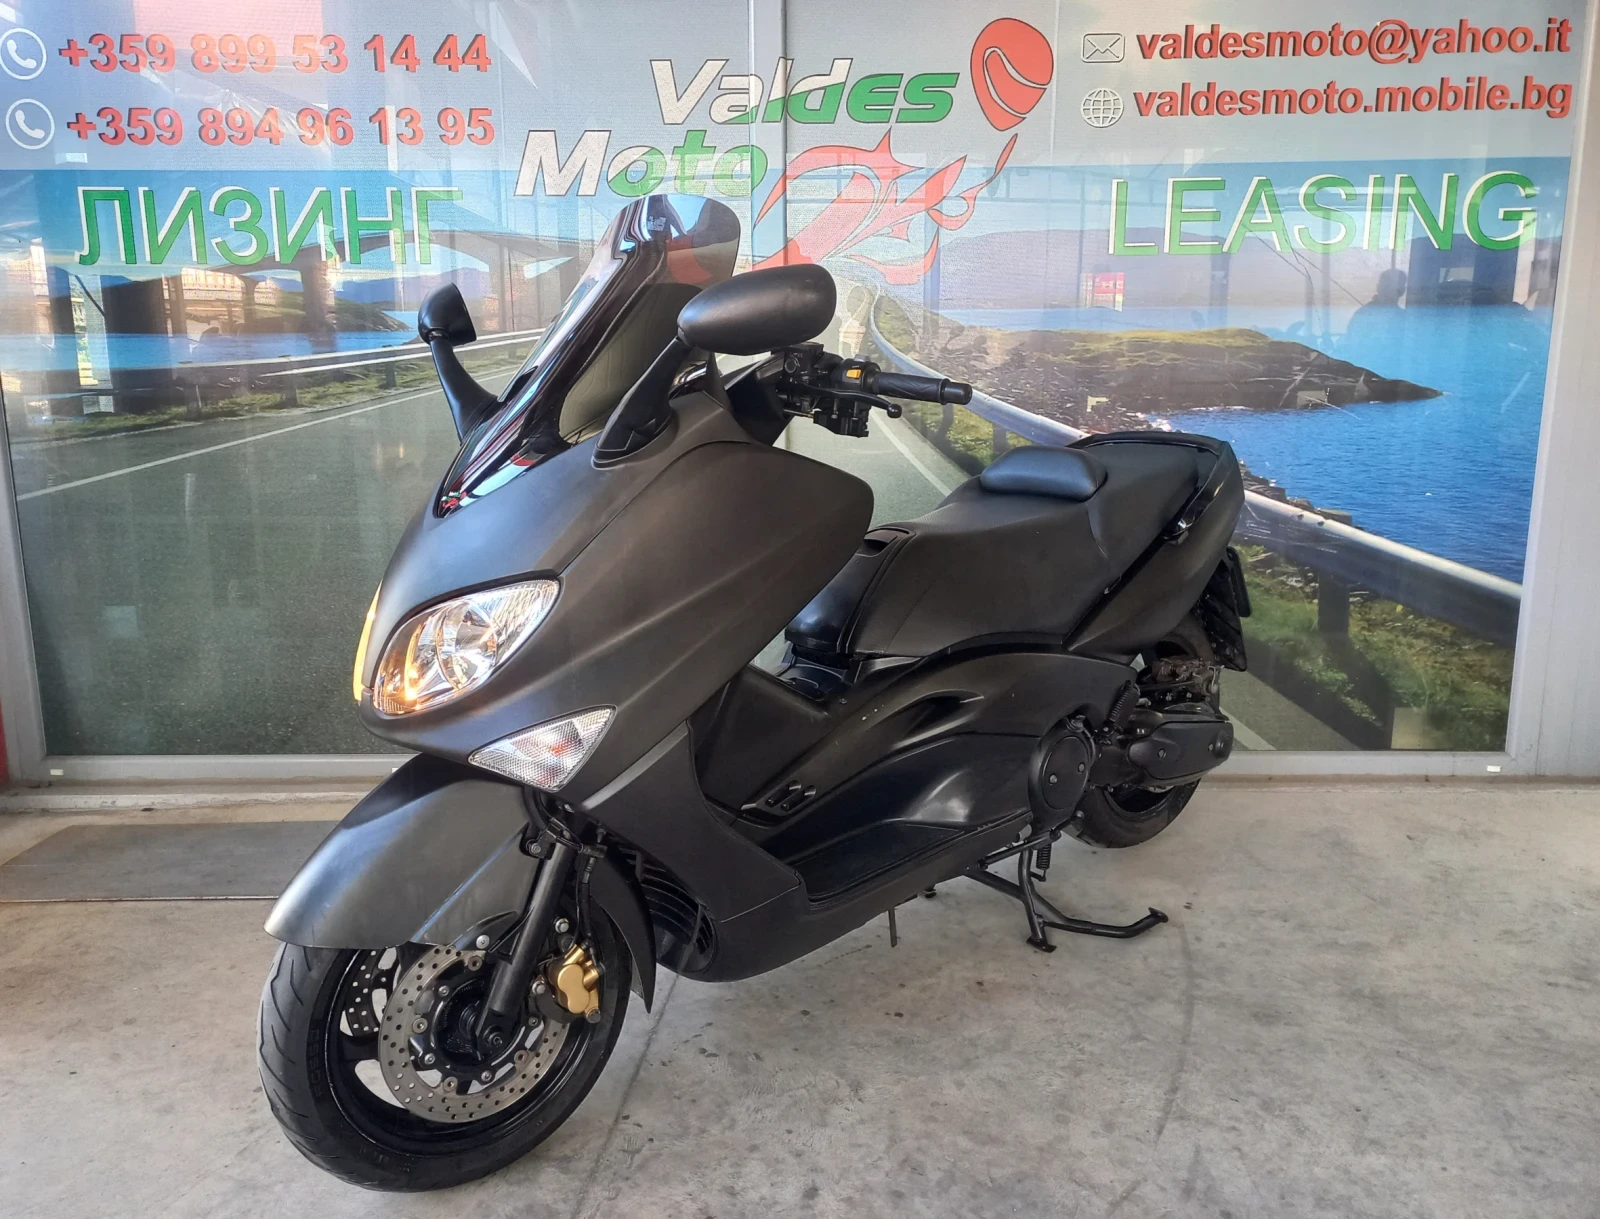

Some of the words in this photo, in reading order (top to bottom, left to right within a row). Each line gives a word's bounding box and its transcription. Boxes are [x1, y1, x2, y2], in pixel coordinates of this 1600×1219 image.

[59, 34, 176, 73] +359
[190, 34, 277, 73] 899
[292, 34, 348, 73] 53
[364, 34, 421, 72] 14
[433, 34, 492, 72] 44
[1137, 17, 1572, 64] valdesmoto@yahoo.it
[649, 58, 960, 124] Valdes
[1133, 76, 1573, 118] valdesmoto.mobile.bg
[67, 107, 184, 146] +359
[198, 107, 284, 145] 894
[296, 108, 355, 145] 96
[369, 108, 424, 145] 13
[437, 107, 495, 145] 95
[514, 129, 768, 198] Moto
[76, 186, 463, 265] ЛИЗИНГ
[1108, 170, 1538, 256] LEASING
